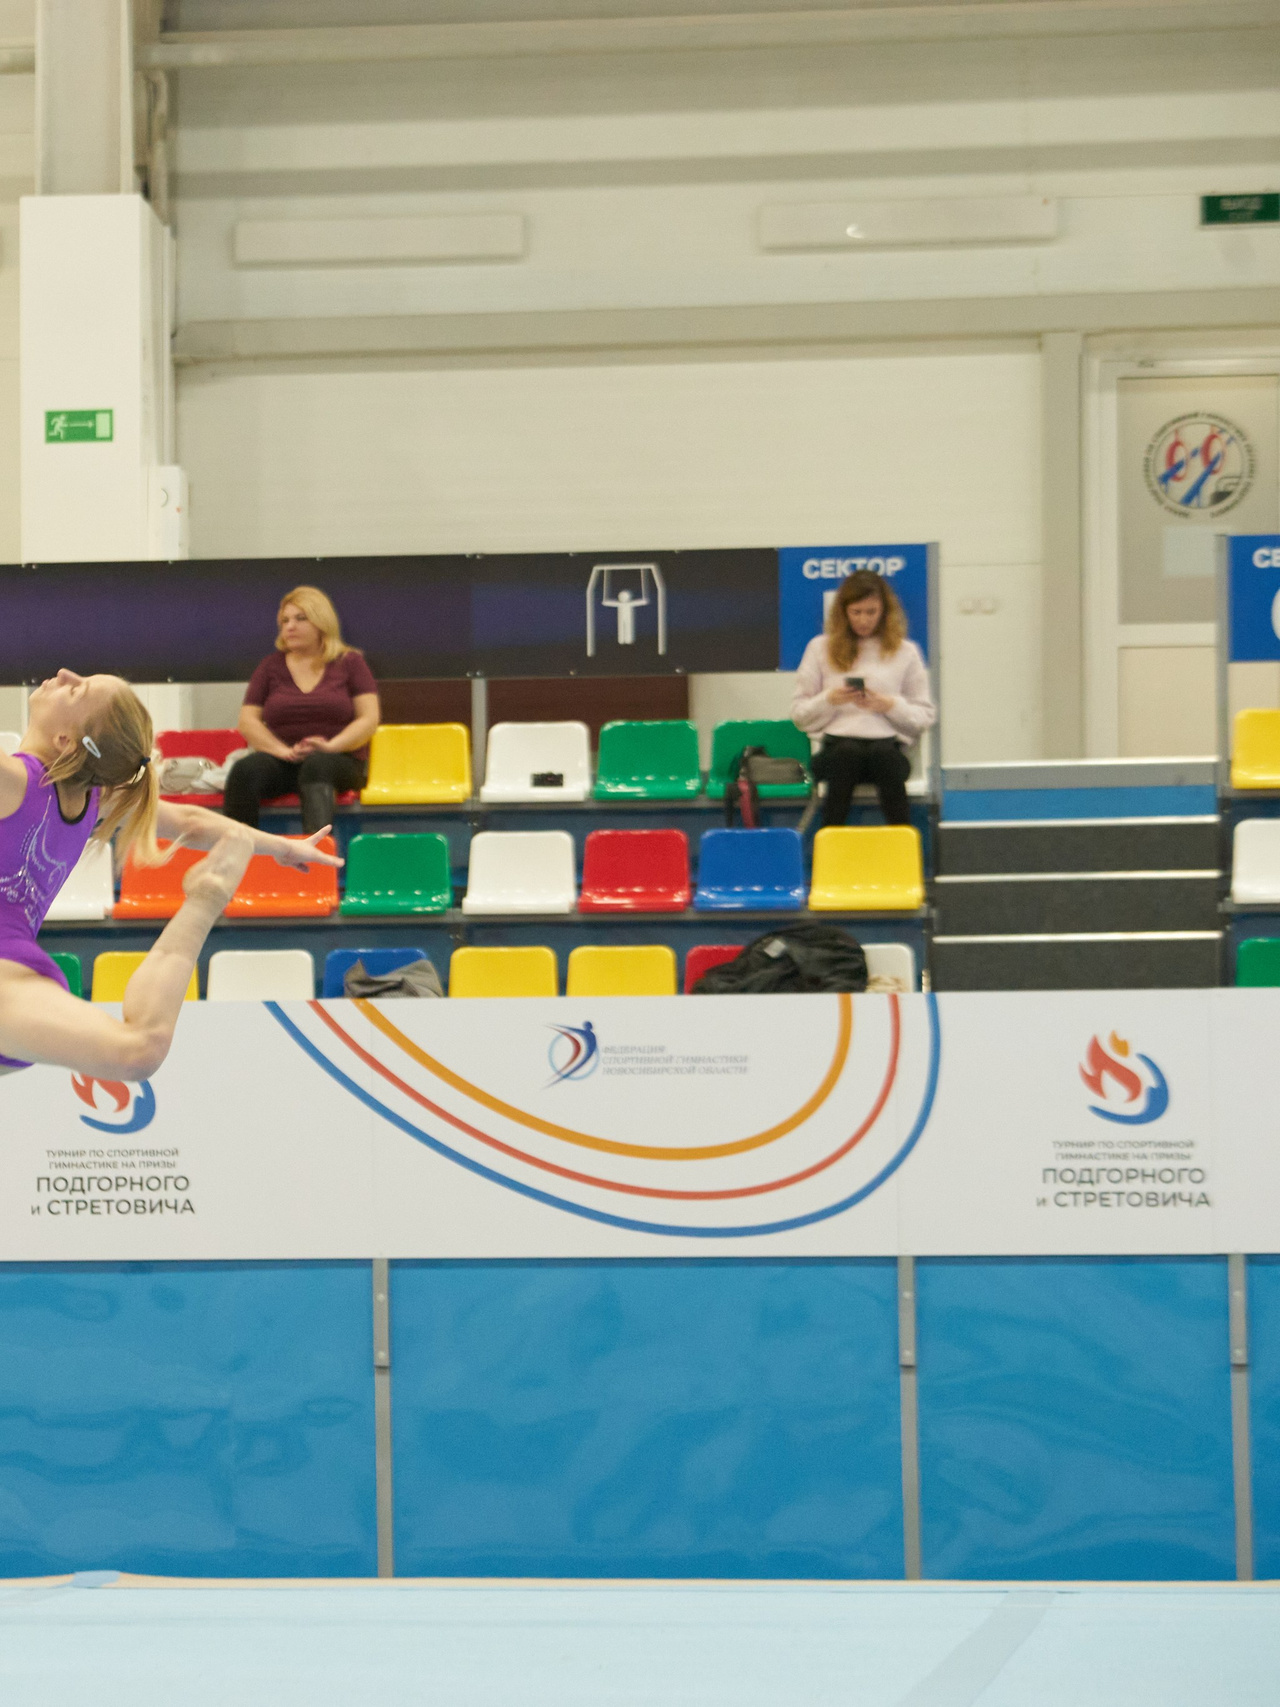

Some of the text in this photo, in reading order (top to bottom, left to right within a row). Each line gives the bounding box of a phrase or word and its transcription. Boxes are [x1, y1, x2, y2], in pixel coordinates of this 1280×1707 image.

[802, 556, 905, 579] СЕКТОР
[602, 1055, 673, 1065] СПОРТИВНОЙ
[1052, 1139, 1195, 1149] ТУРНИР ПО СПОРТИВНОЙ
[46, 1148, 179, 1158] ТУРНИР ПО СПОРТИВНОЙ
[1056, 1152, 1192, 1161] ГИМНАСТИКЕ НА ПРИЗЫ
[49, 1161, 176, 1170] ГИМНАСТИКЕ НА ПРИЗЫ
[1042, 1168, 1207, 1187] ПОДГОРНОГО
[37, 1176, 190, 1194] ПОДГОРНОГО
[1054, 1191, 1211, 1207] СТРЕТОВИЧА
[47, 1199, 195, 1215] СТРЕТОВИЧА
